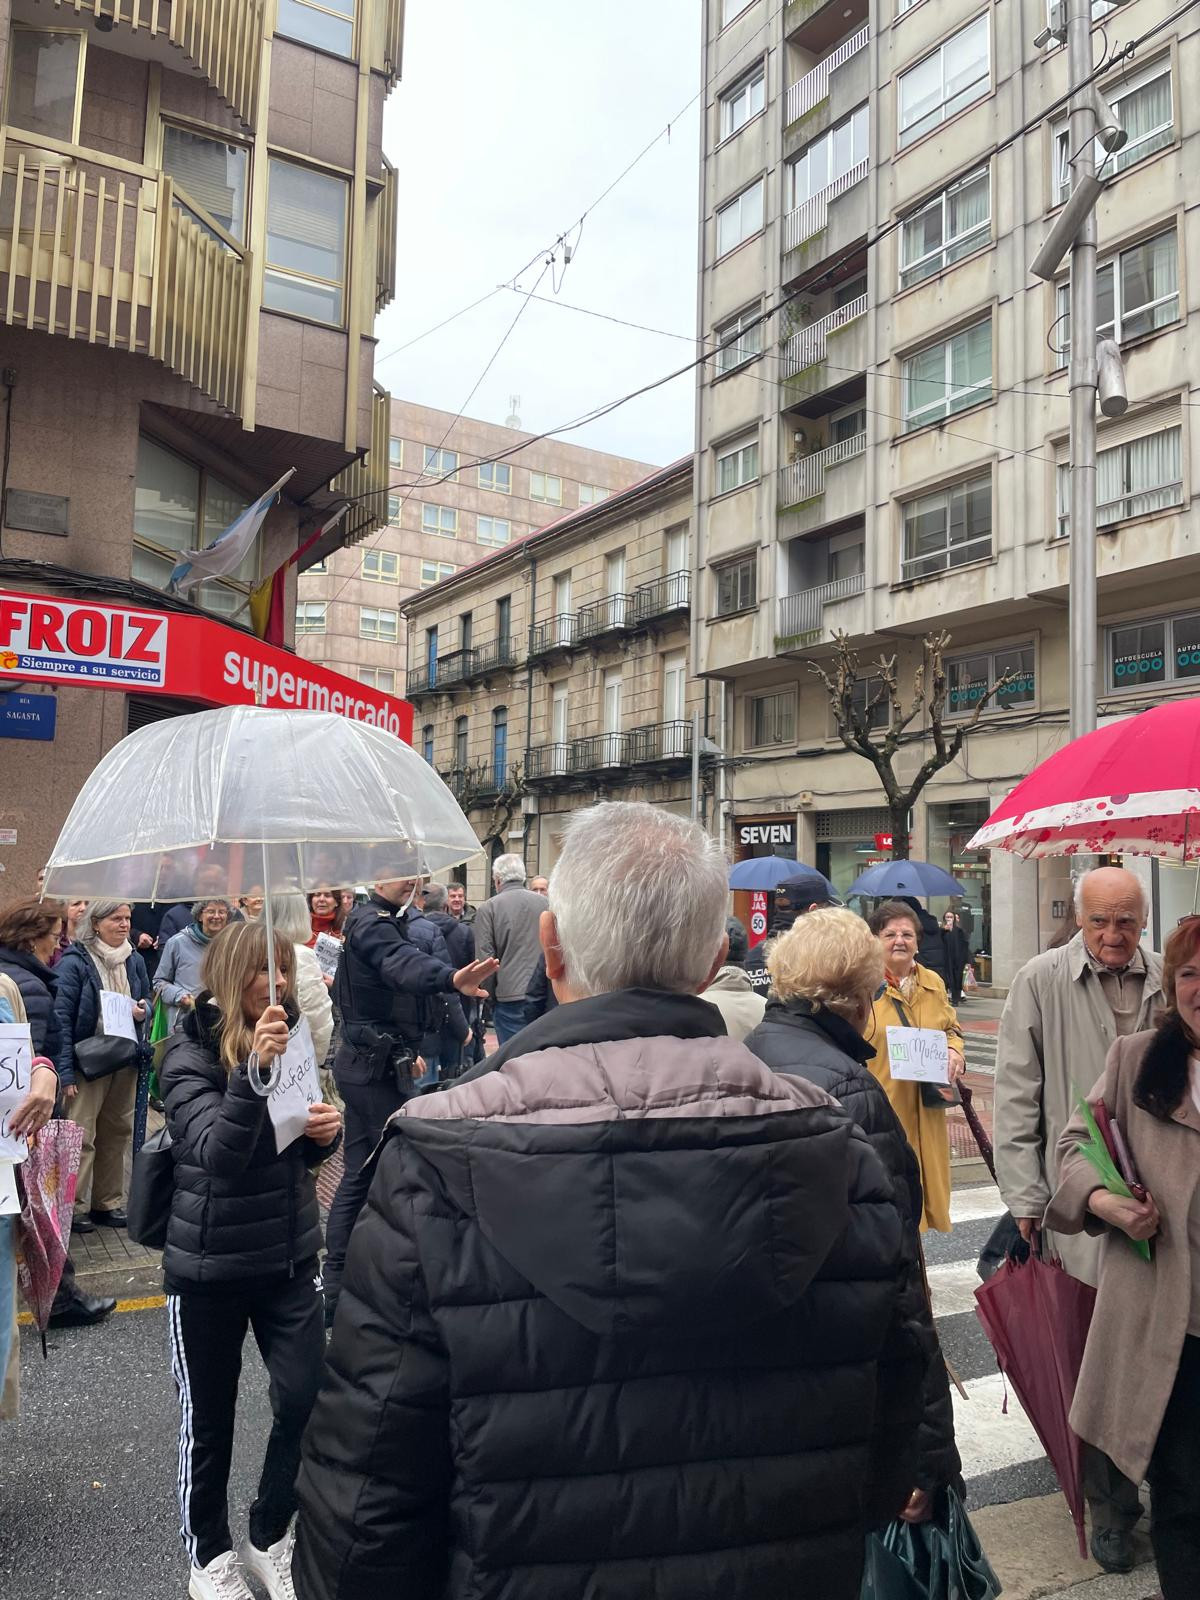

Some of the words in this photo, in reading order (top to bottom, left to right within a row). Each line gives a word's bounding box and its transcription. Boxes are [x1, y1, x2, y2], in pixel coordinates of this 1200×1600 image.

[0, 600, 164, 663] FROIZ
[1114, 651, 1163, 663] AUTOESCUELA
[21, 656, 76, 672] Siempre
[79, 665, 88, 673] a
[92, 667, 107, 675] su
[111, 668, 159, 681] servicio
[223, 651, 400, 737] supermercado
[6, 711, 40, 721] SAGASTA
[740, 824, 792, 845] SEVEN
[751, 902, 767, 911] JAS
[753, 918, 764, 930] 50
